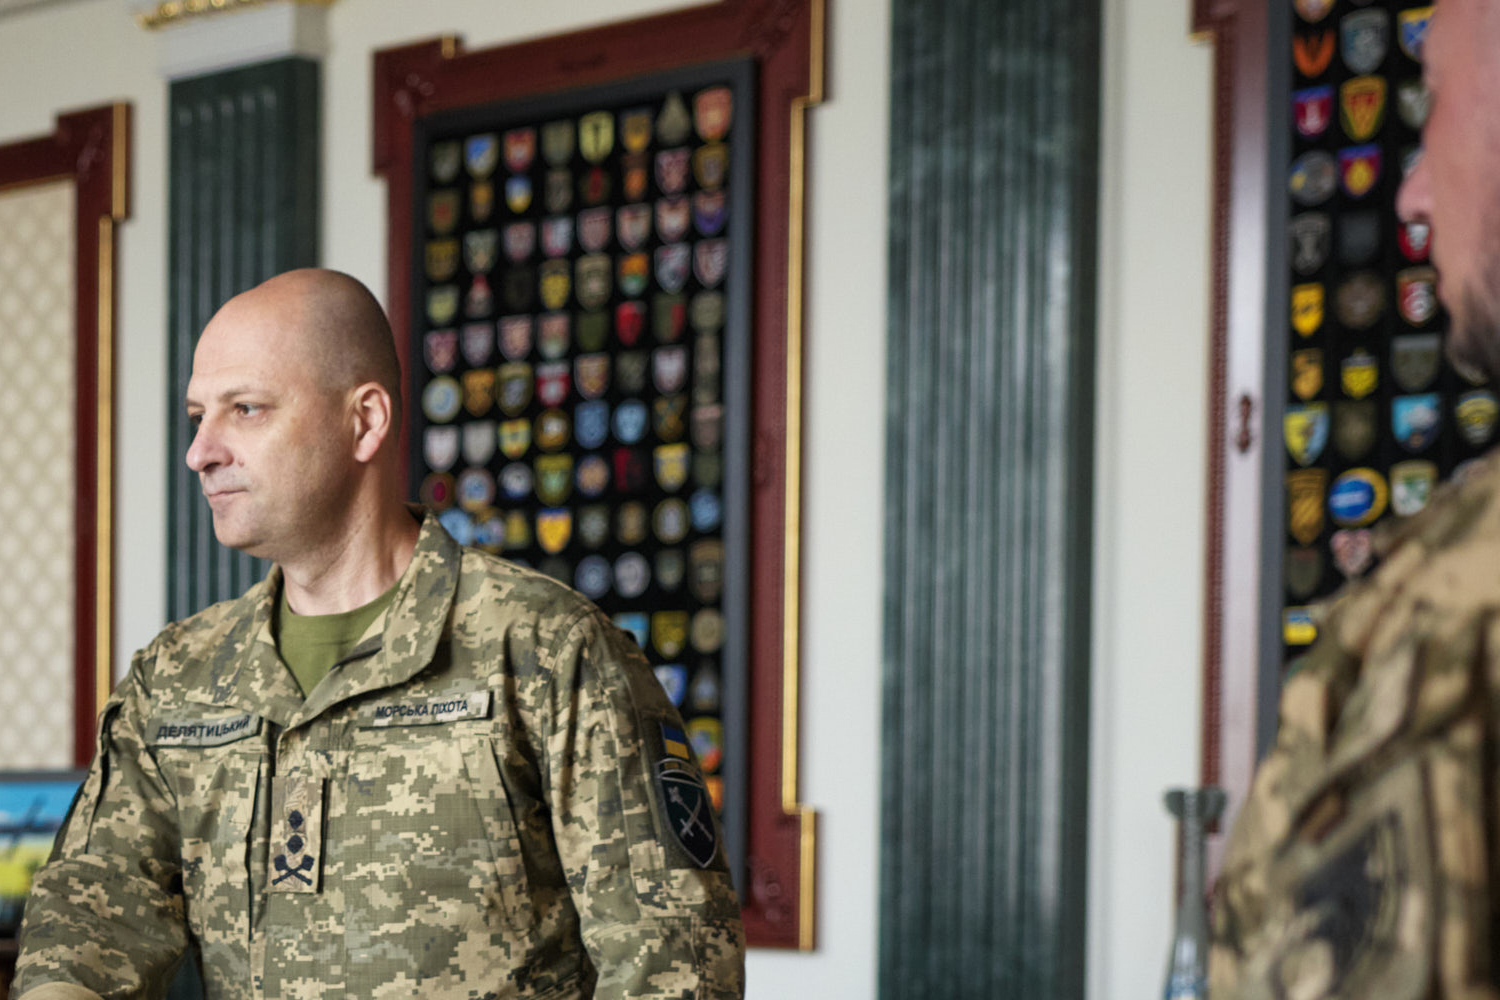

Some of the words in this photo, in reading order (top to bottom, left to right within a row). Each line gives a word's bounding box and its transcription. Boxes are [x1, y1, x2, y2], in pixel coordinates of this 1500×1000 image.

[376, 704, 428, 717] МОРСЬКА
[431, 700, 468, 715] ПІХОТА
[156, 714, 251, 739] ДЕЛЯТИЦЬКИЙ
